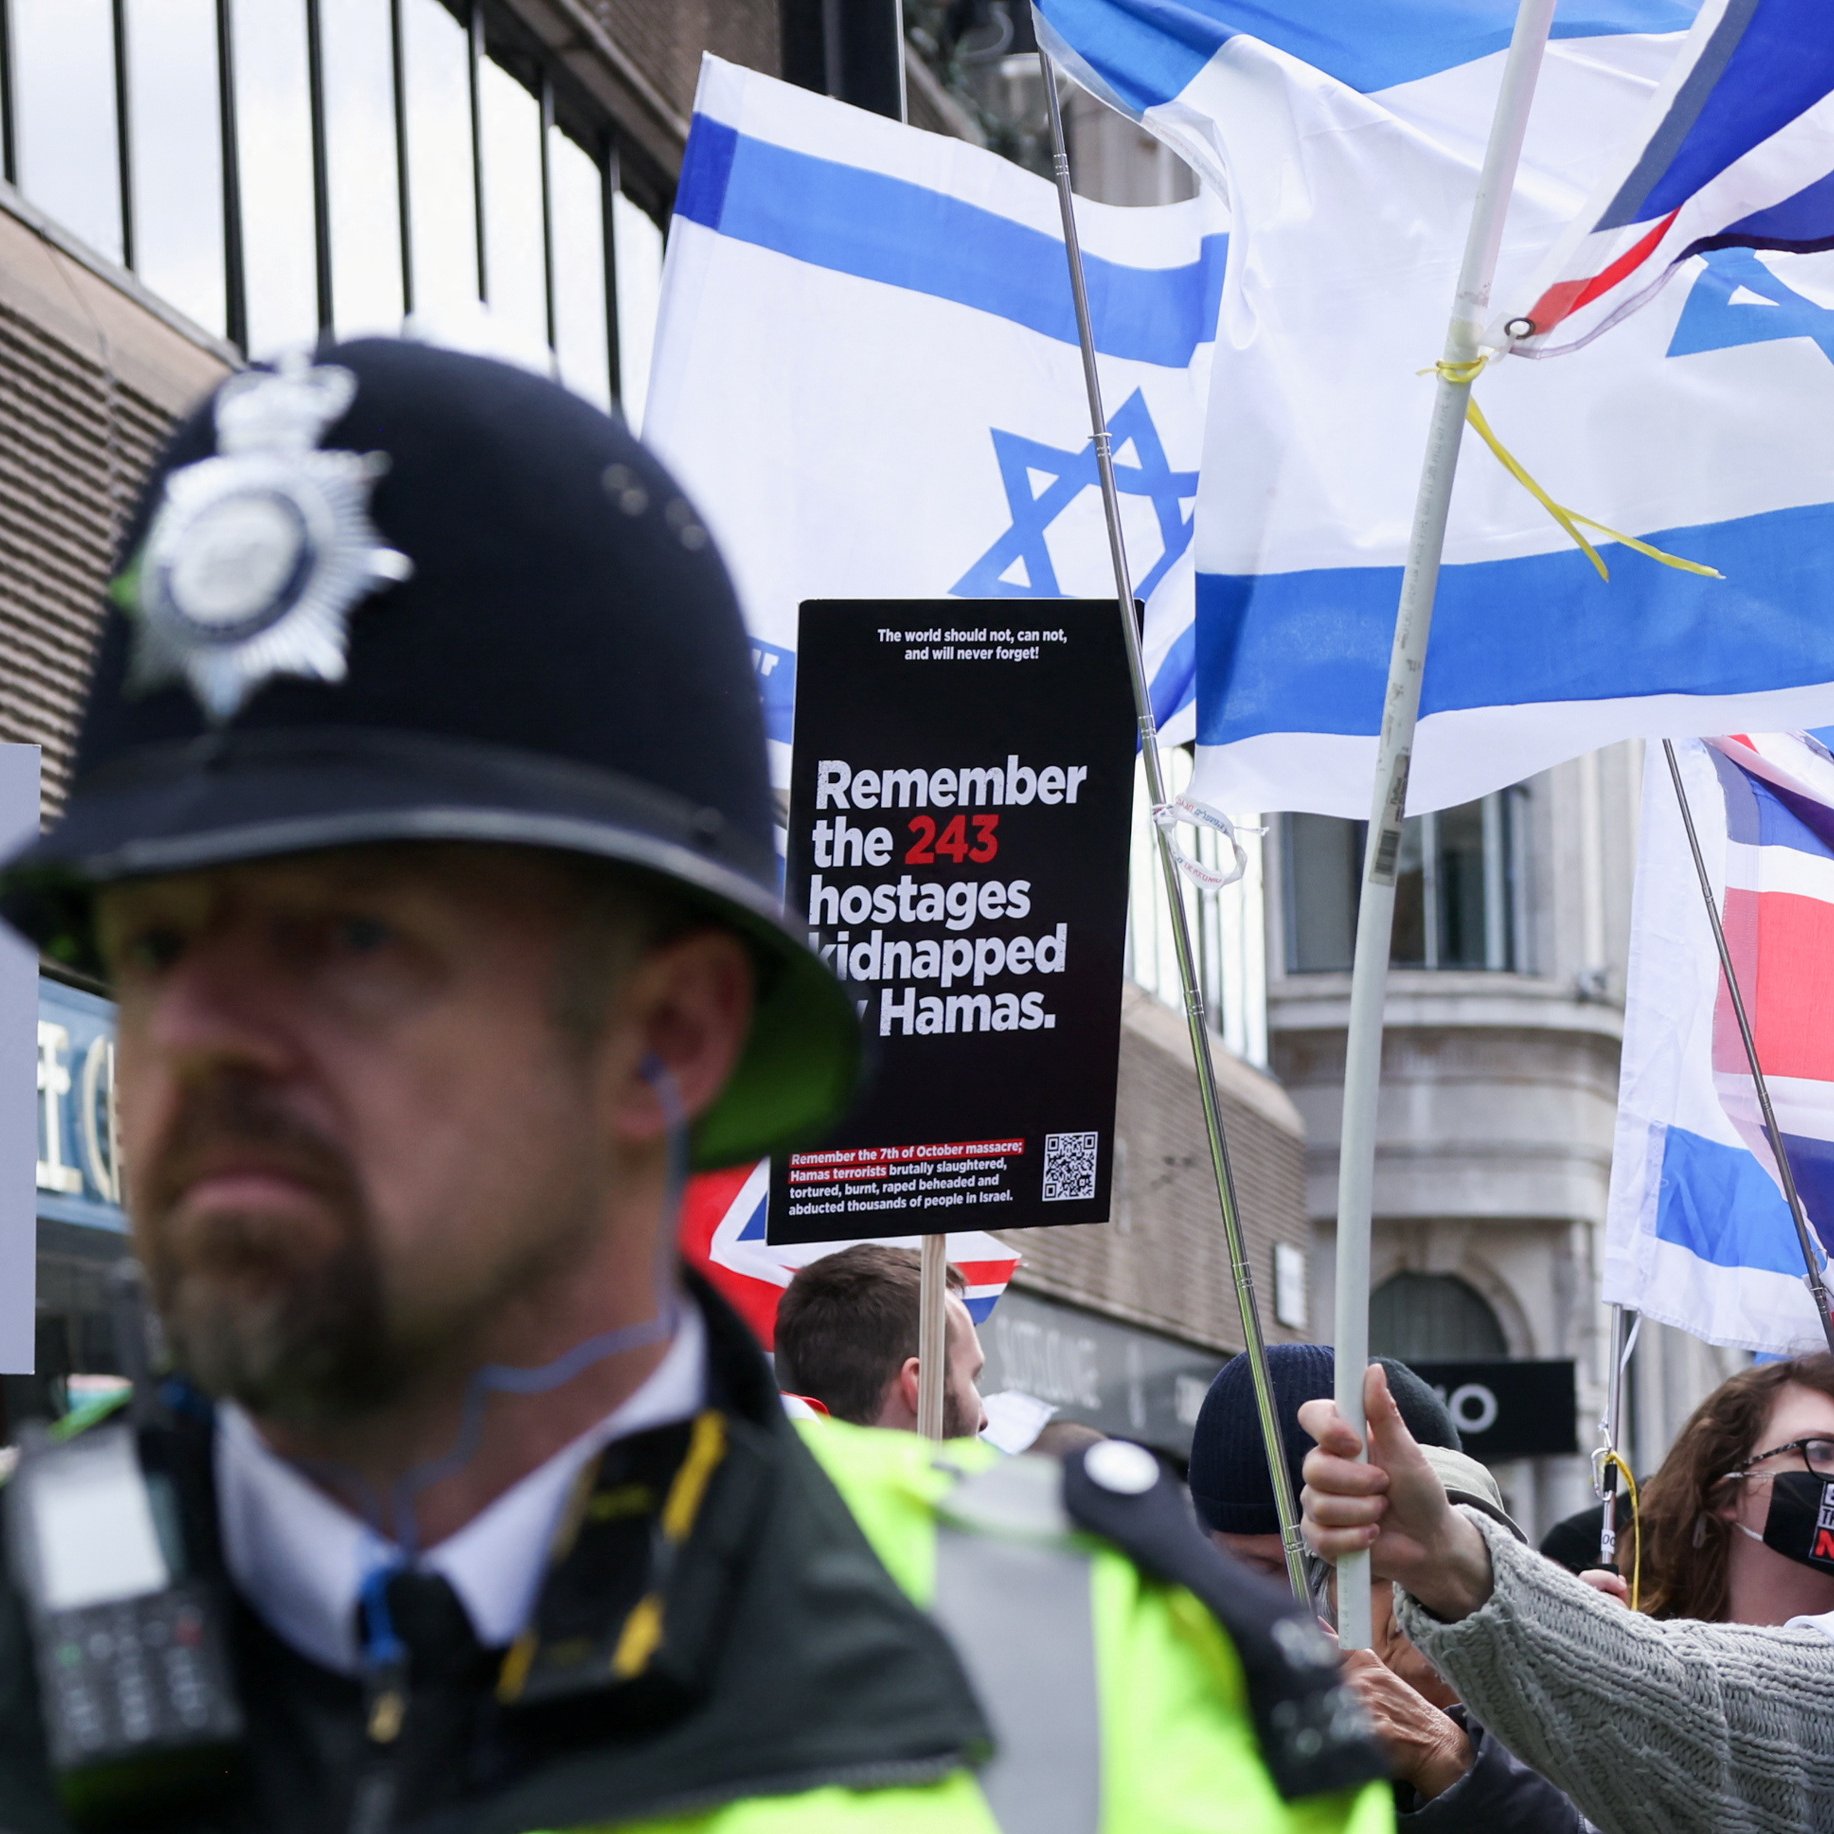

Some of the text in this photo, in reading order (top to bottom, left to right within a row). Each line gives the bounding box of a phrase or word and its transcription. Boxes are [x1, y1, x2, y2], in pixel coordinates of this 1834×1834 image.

[878, 628, 1067, 644] The world should not, can not,
[905, 646, 1039, 662] and will never forget!
[817, 755, 1087, 810] Remember
[812, 814, 999, 868] the 243
[809, 874, 1031, 930] hostages
[879, 987, 1055, 1036] Hamas.
[792, 1141, 1022, 1165] Remember the 7th of October massacre;
[791, 1157, 1007, 1181] Hamas terrorists brutally slaughtered,
[790, 1174, 999, 1199] tortured, burnt, raped beheaded and
[789, 1189, 1013, 1215] abducted thousands of people in Israel.
